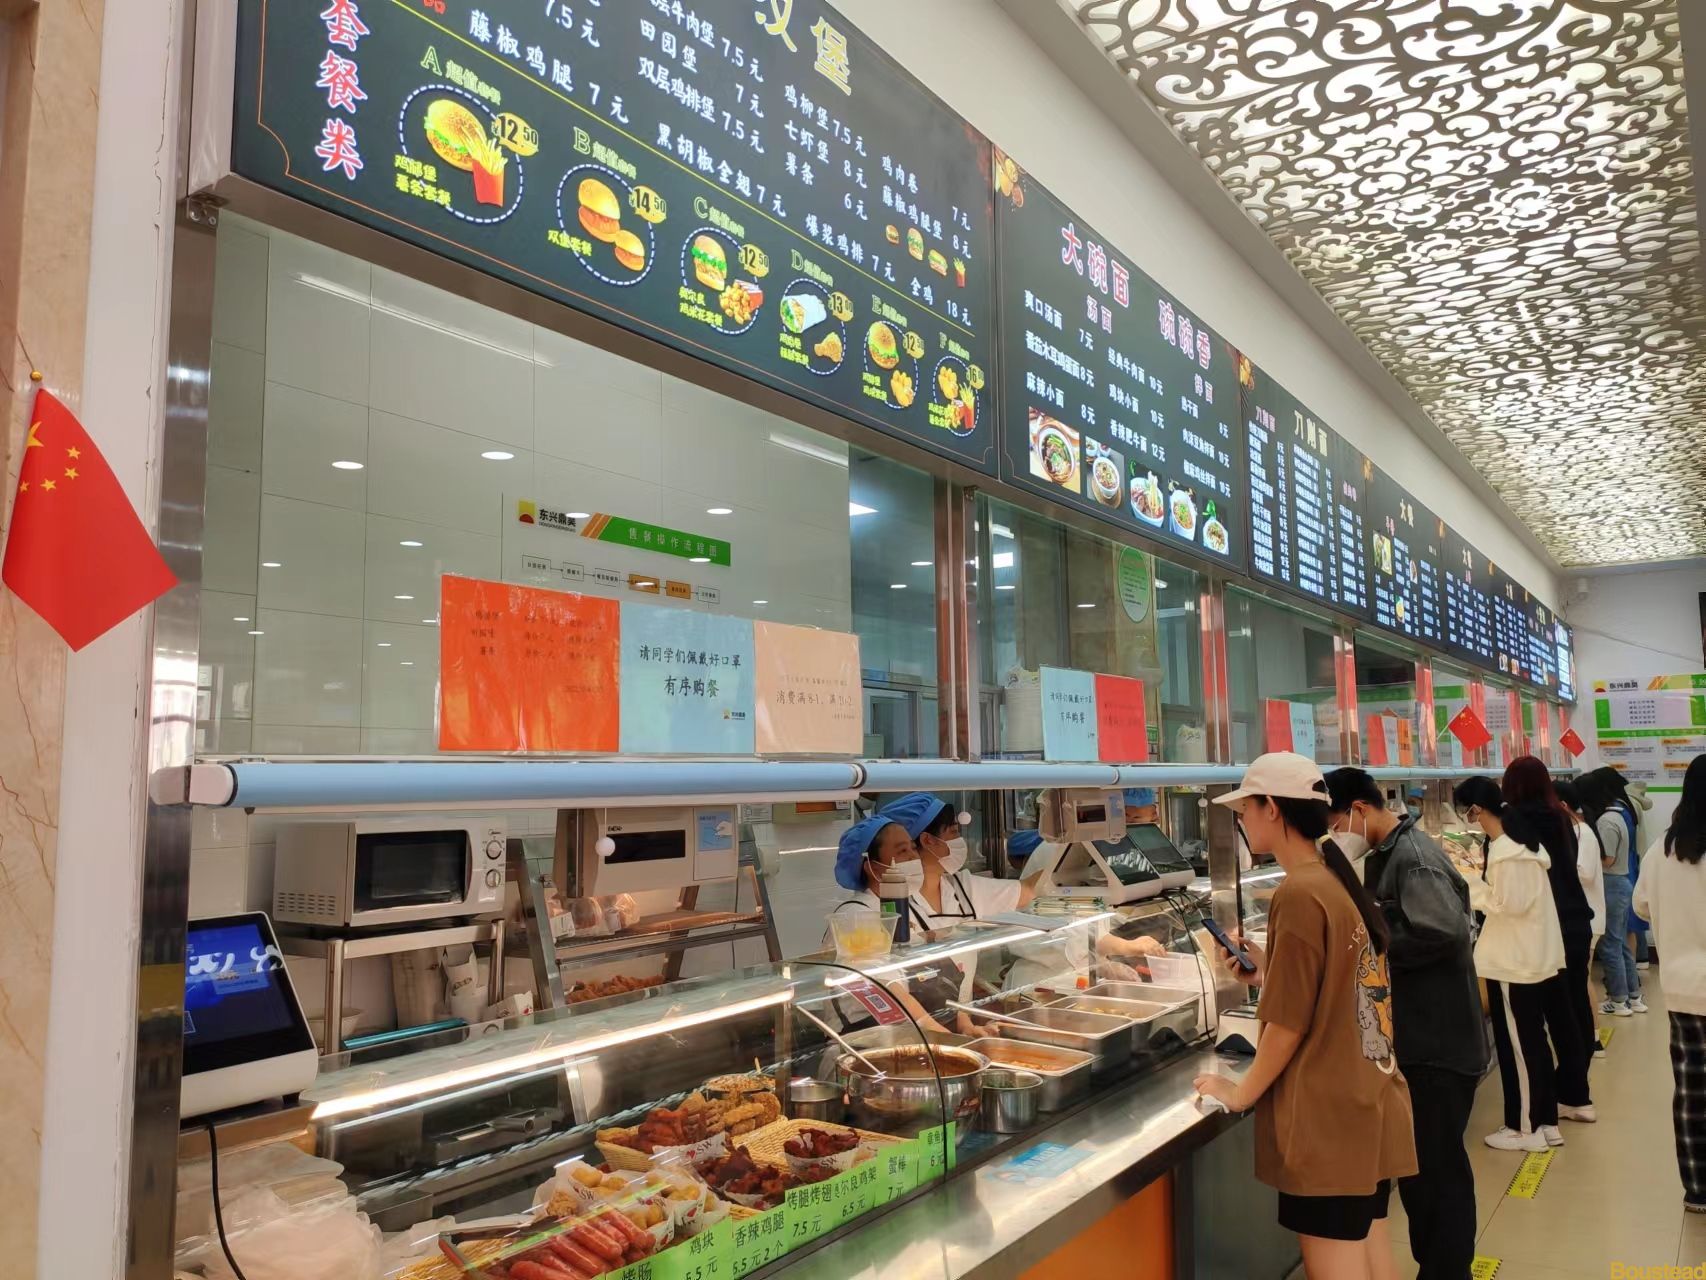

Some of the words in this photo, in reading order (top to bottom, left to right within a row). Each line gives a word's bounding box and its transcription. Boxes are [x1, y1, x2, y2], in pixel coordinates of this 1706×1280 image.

[420, 45, 443, 76] A
[651, 0, 716, 48] 层牛肉堡
[721, 36, 764, 83] 7.5元
[468, 8, 574, 92] 藤椒鸡腿
[588, 81, 629, 125] 7元
[640, 19, 698, 73] 田园堡
[735, 82, 765, 118] 7元
[314, 0, 371, 181] 套餐类
[637, 56, 716, 123] 双层鸡排堡
[721, 110, 765, 154] 7.5元
[784, 84, 829, 131] 鸡柳堡
[832, 119, 867, 157] 7.5元
[573, 126, 591, 155] B
[656, 122, 752, 198] 黑胡椒全翅
[756, 184, 787, 218] 7元
[843, 159, 868, 189] 8元
[881, 155, 918, 194] 鸡肉卷
[693, 196, 709, 219] C
[843, 192, 869, 221] 6元
[882, 185, 943, 241] 藤椒鸡腿堡
[805, 213, 864, 264] 爆浆鸡排
[872, 254, 896, 283] 7元
[1061, 222, 1130, 308] 大碗面
[910, 276, 934, 306] 全鸡
[946, 299, 972, 327] 18元
[1026, 371, 1065, 409] 麻辣小面
[639, 644, 742, 670] 请同学们佩戴好口罩
[664, 675, 720, 698] 有序购餐
[786, 1183, 832, 1211] 烤腿烤翅
[842, 1194, 866, 1217] 6.5元
[690, 1229, 714, 1256] 鸡块
[734, 1210, 785, 1249] 香辣鸡腿
[792, 1214, 823, 1238] 7.5元
